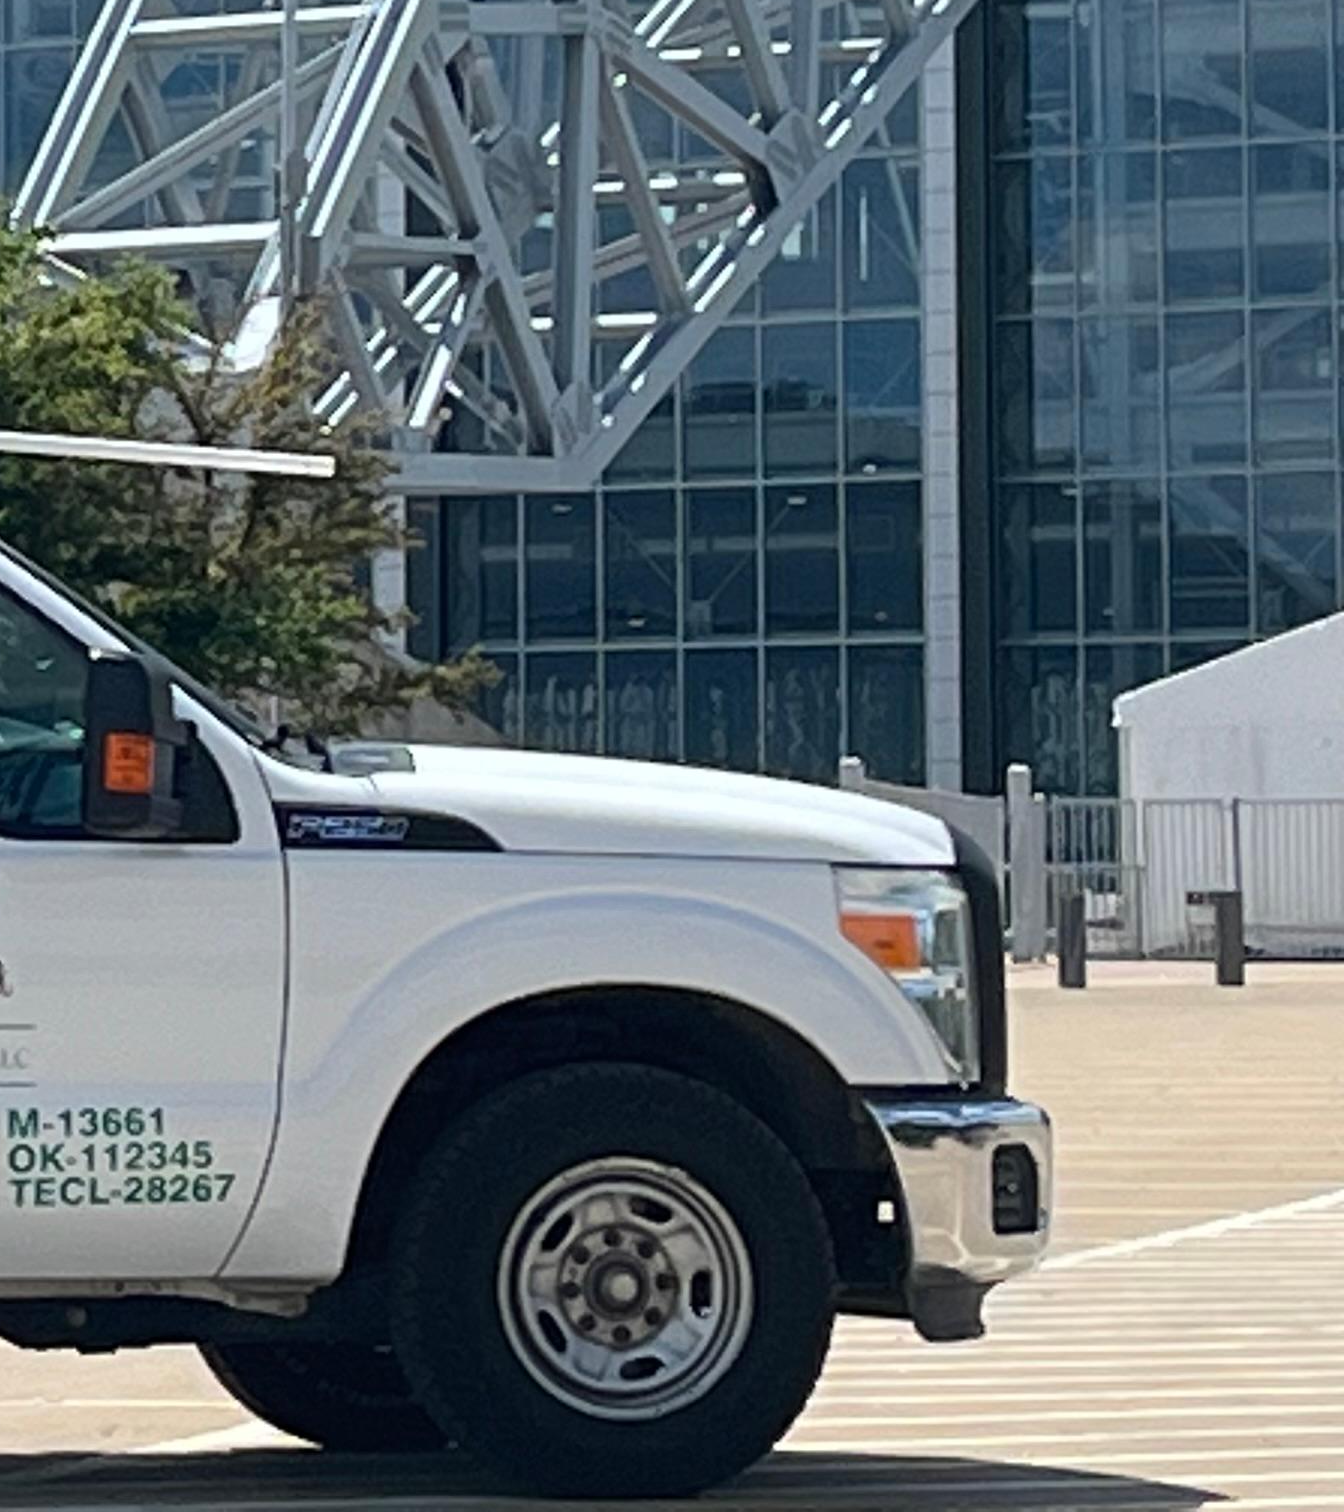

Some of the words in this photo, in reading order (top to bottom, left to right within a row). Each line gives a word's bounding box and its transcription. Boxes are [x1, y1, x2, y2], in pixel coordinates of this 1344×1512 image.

[7, 1107, 164, 1138] M-13661
[7, 1140, 213, 1173] OK-112345
[7, 1173, 236, 1208] TECL-28267
